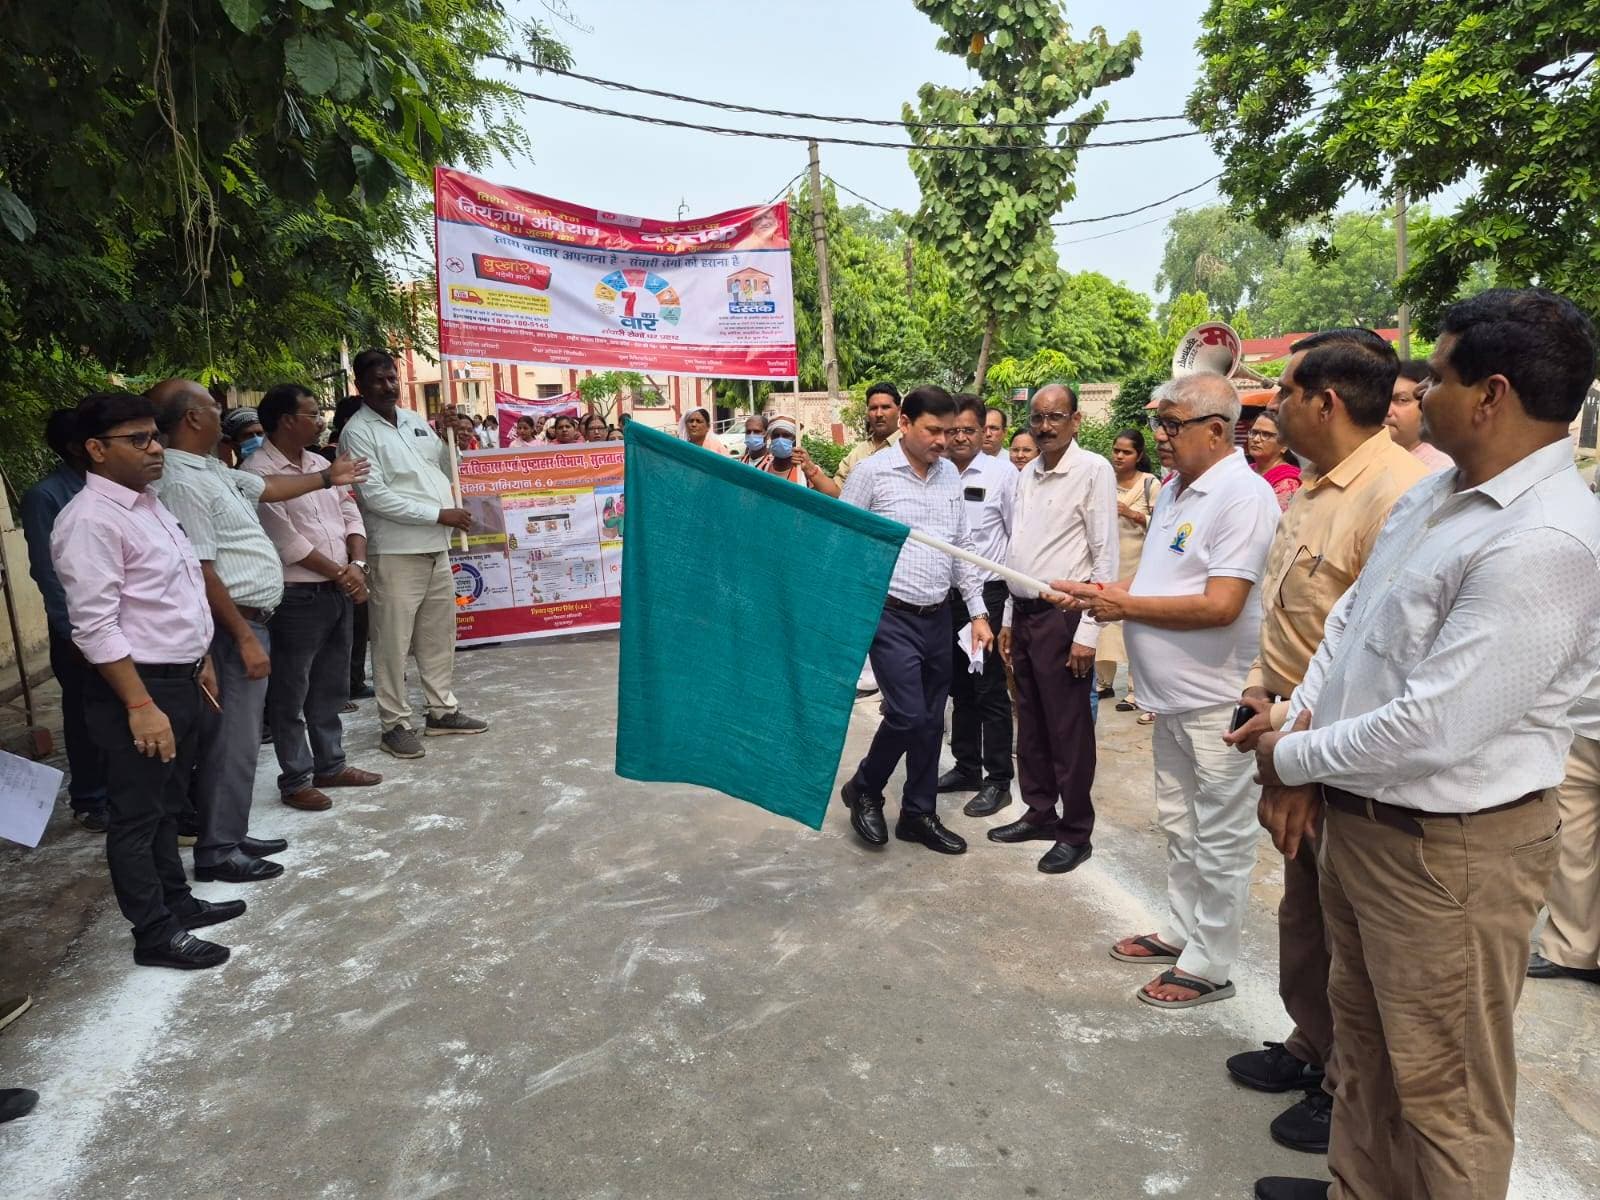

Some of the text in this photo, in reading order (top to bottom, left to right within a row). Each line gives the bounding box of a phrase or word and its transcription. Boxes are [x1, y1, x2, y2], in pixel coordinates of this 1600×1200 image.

[458, 196, 525, 226] नियंत्रण
[531, 214, 600, 238] अभियान
[639, 223, 743, 245] दस्तक
[483, 258, 530, 275] बुखार
[562, 249, 606, 265] अपनाना
[610, 254, 617, 265] है
[630, 256, 658, 268] संचारी
[662, 256, 681, 268] रोगों
[684, 255, 698, 268] को
[701, 258, 728, 268] हराना
[732, 255, 740, 267] है
[621, 291, 637, 317] 7
[730, 304, 773, 313] दस्तक
[492, 318, 549, 329] 1800-180-5145
[619, 316, 659, 331] वार
[470, 459, 501, 475] विकास
[504, 456, 519, 472] एवं
[521, 457, 555, 475] पुष्टाहार
[488, 477, 532, 492] अभियान
[535, 478, 553, 489] 6.0
